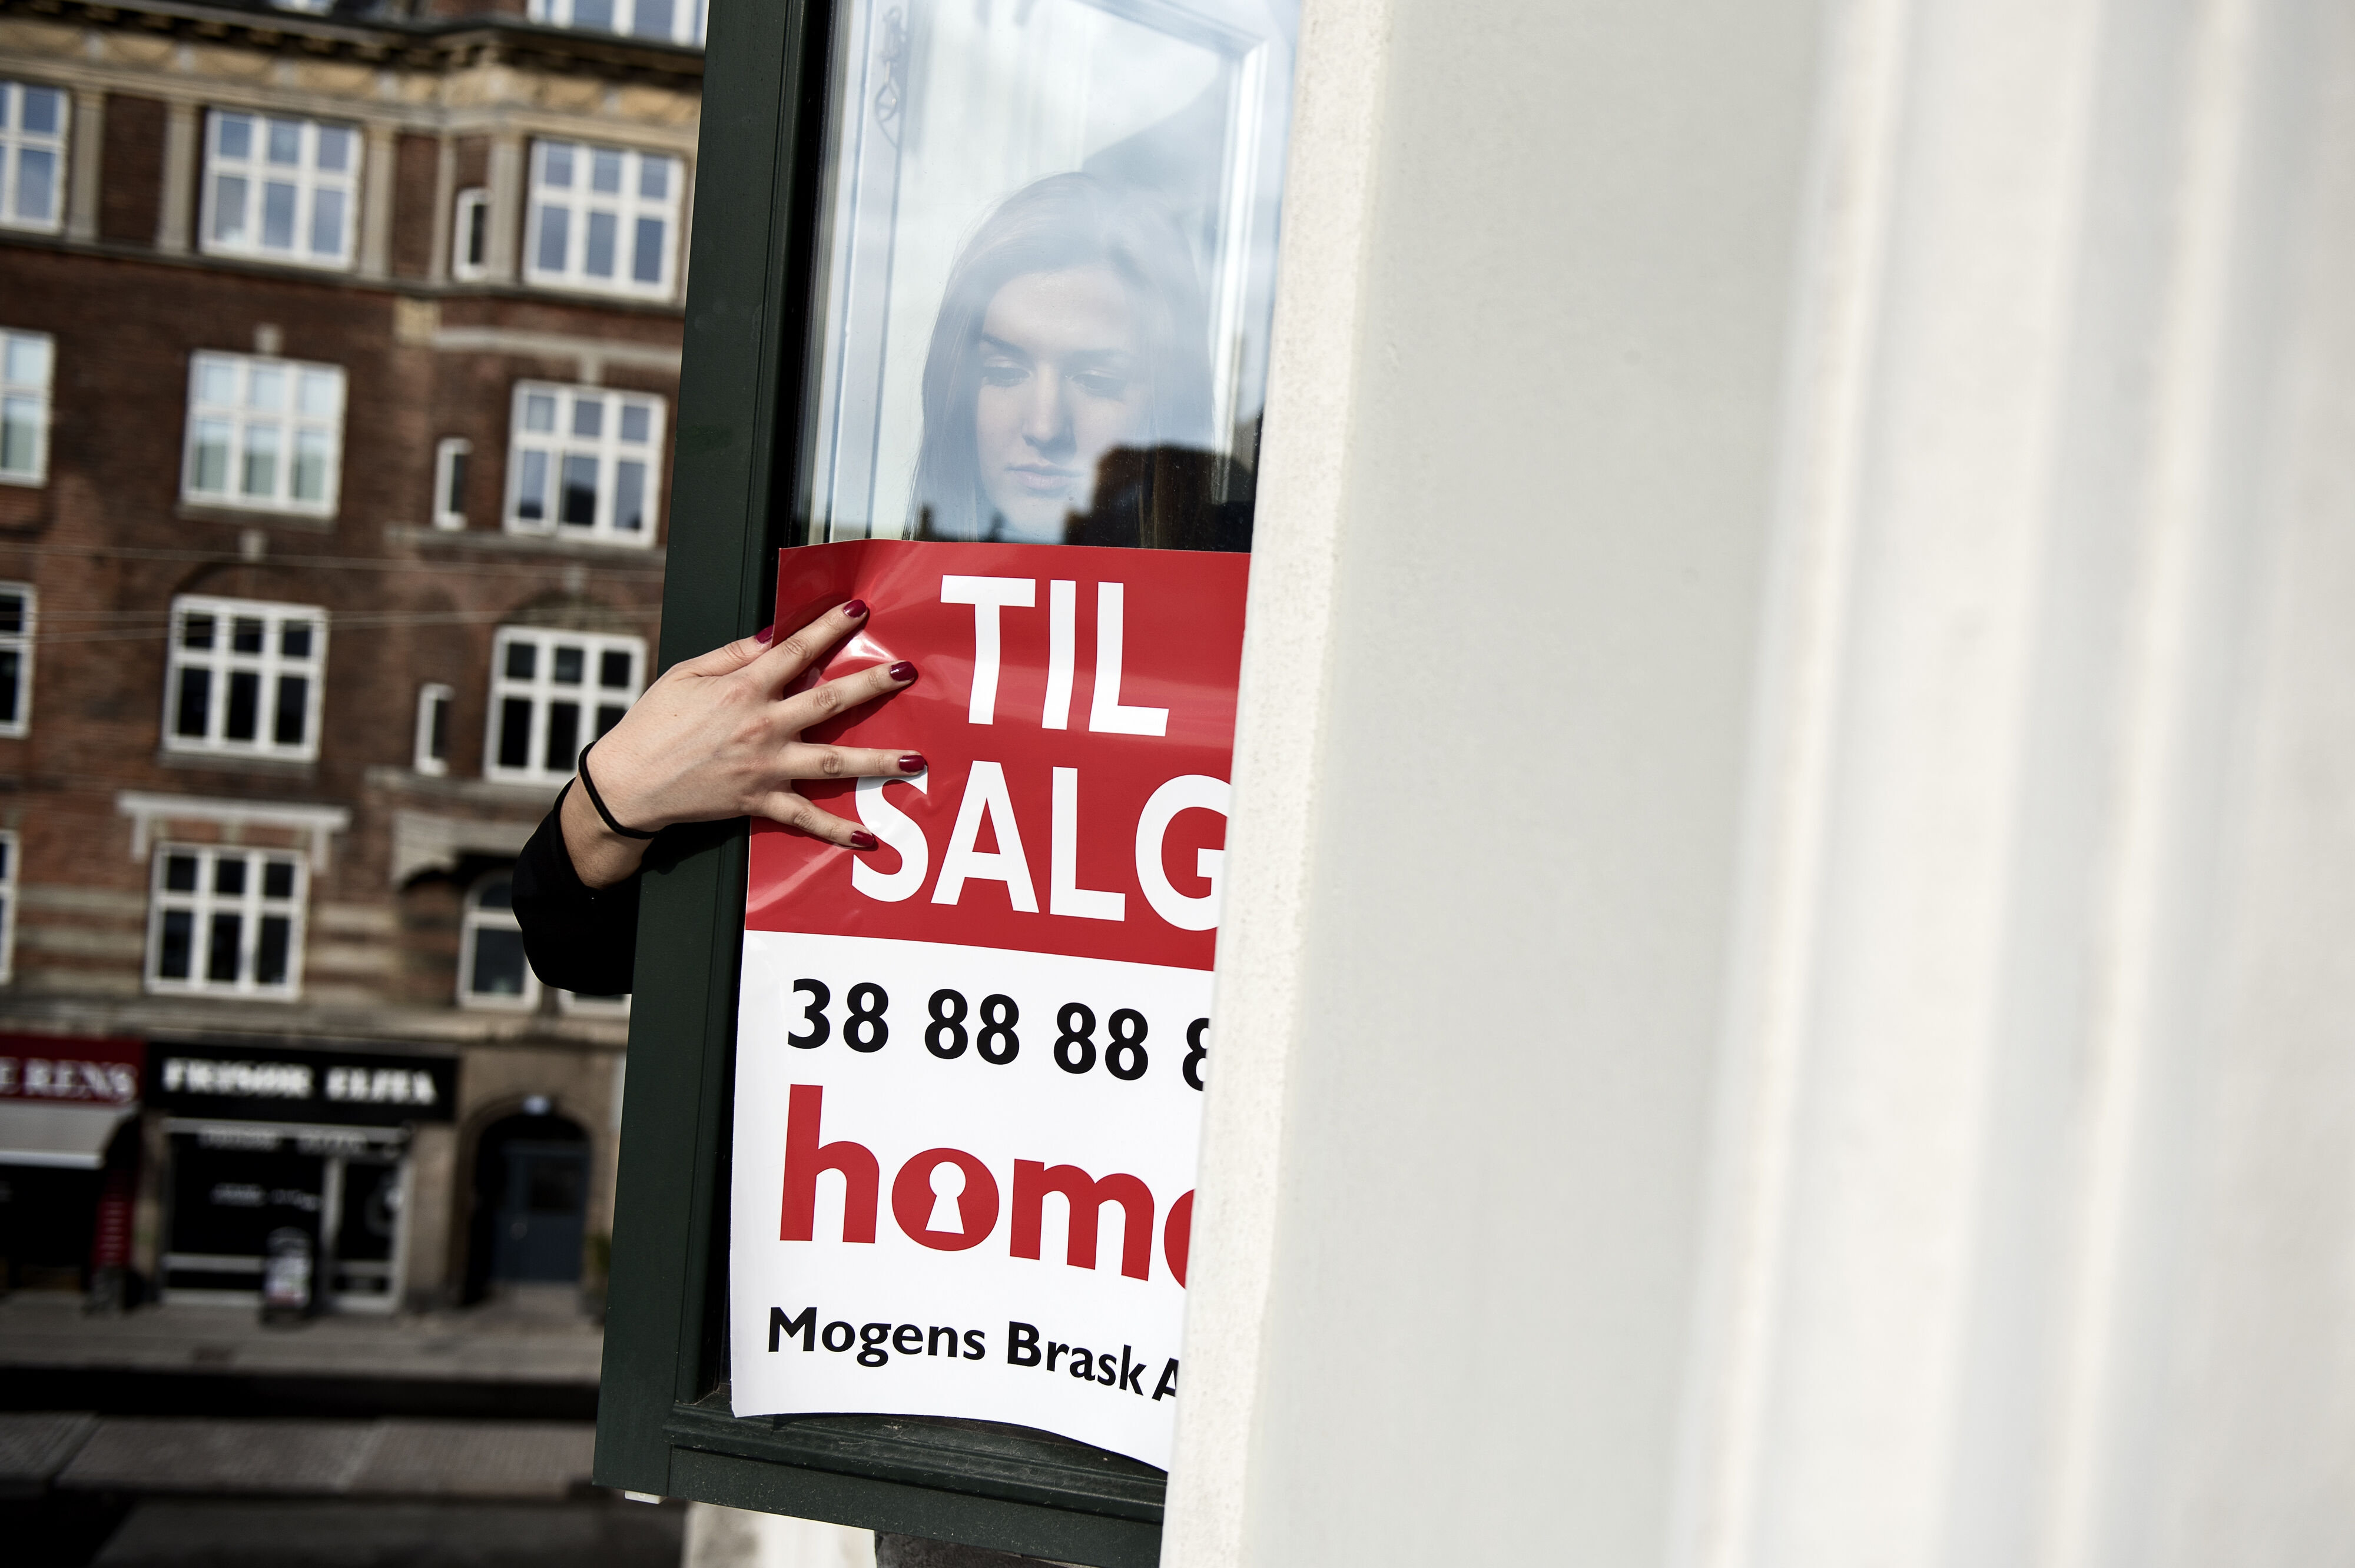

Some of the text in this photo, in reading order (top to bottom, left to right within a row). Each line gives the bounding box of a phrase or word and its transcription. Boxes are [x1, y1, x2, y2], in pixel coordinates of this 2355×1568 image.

[940, 574, 1169, 737] TIL
[851, 759, 1232, 931] SALG
[25, 1058, 138, 1102] RENS
[787, 978, 889, 1053] 38
[924, 988, 1020, 1065] 88
[1053, 1002, 1149, 1081] 88
[780, 1084, 1196, 1290] hom
[768, 1306, 986, 1368] Mogens
[1006, 1320, 1147, 1396] Brask
